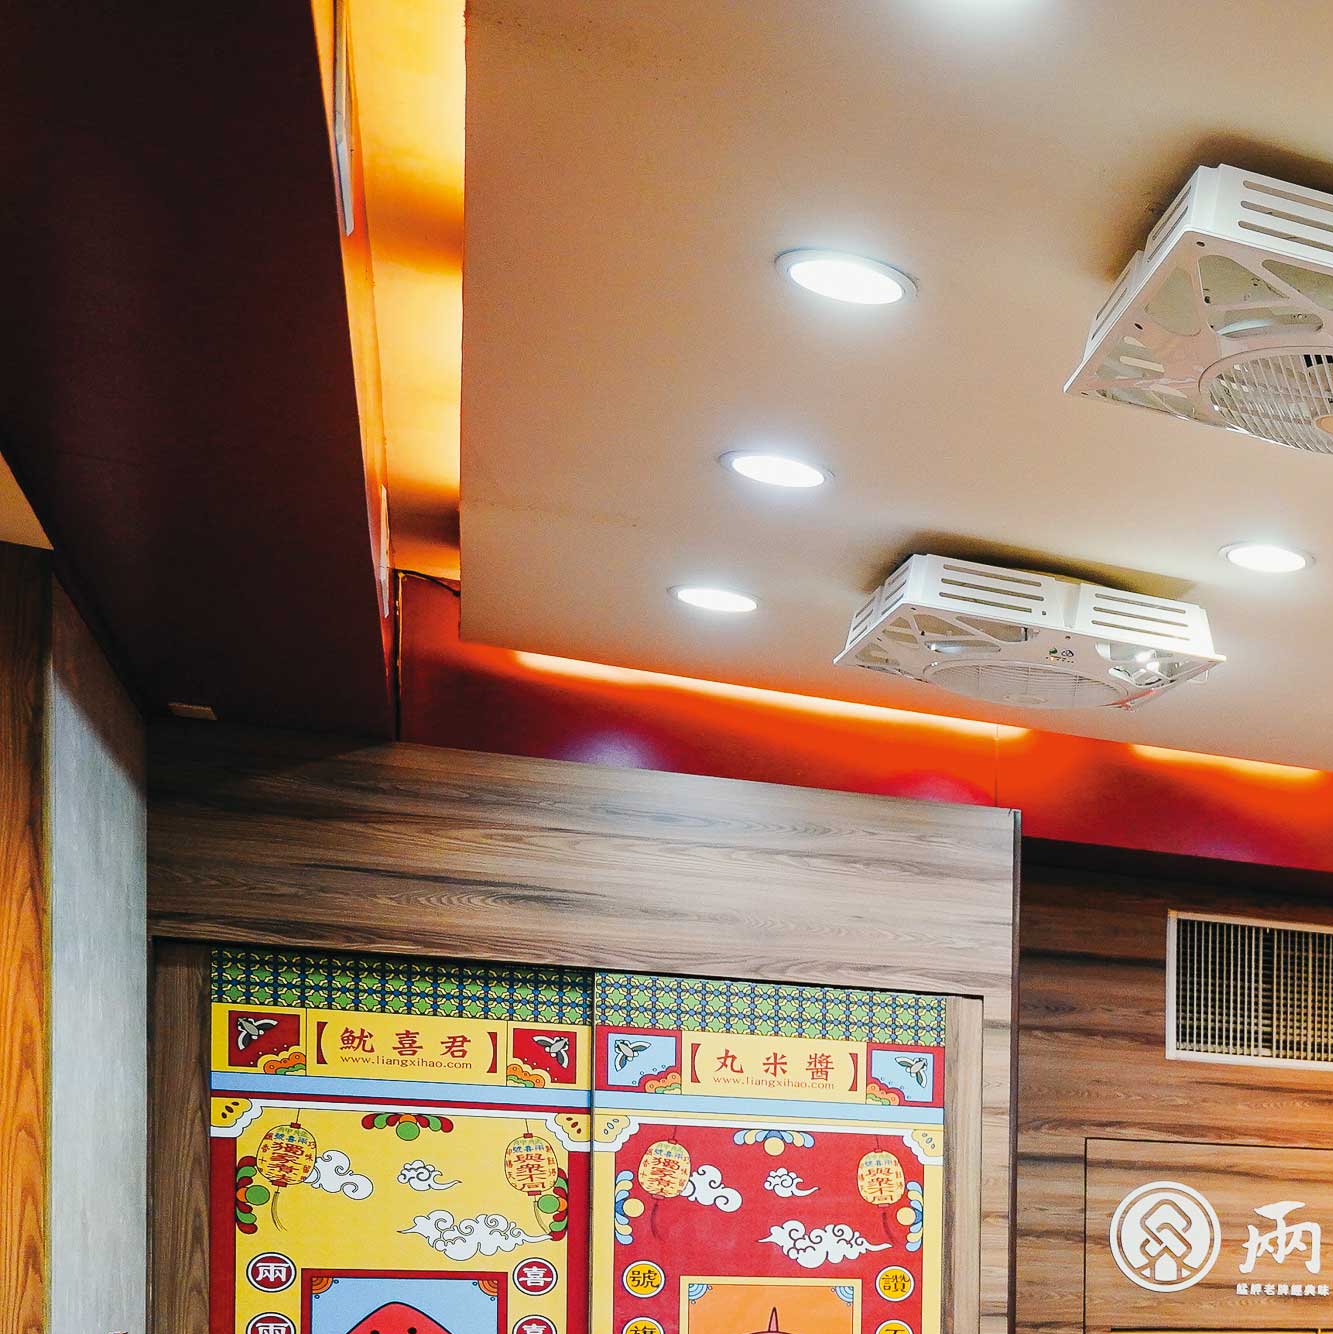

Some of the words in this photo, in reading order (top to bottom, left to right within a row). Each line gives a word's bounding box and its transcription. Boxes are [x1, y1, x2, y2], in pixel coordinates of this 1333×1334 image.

[339, 1027, 472, 1059] 魷喜君
[340, 1053, 473, 1070] www.liangxihao.com
[716, 1048, 835, 1081] 丸米醬
[713, 1074, 836, 1090] www.liangxihao.com
